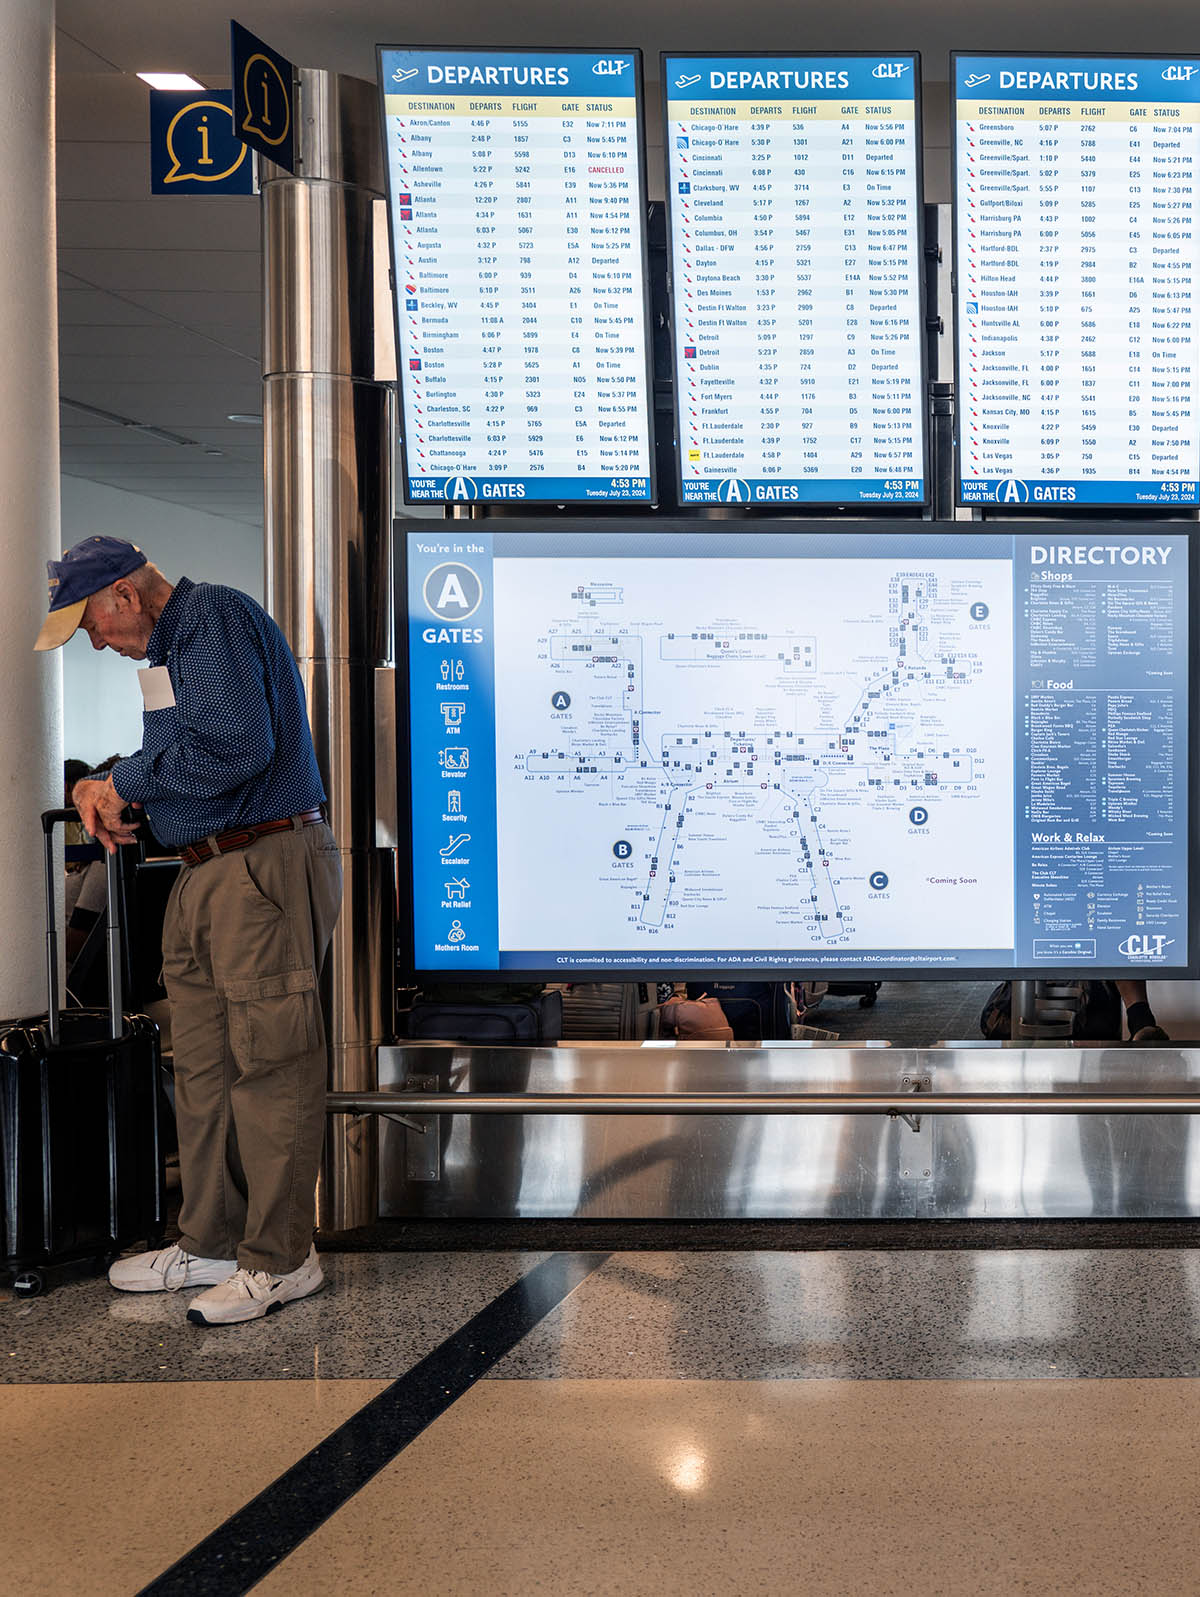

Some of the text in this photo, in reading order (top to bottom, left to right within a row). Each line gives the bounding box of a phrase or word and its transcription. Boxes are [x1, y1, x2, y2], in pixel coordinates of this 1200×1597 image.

[598, 60, 623, 75] CLT
[878, 64, 903, 78] CLT
[1168, 66, 1192, 80] CLT
[428, 66, 568, 85] DEPARTURES
[711, 71, 848, 88] DEPARTURES
[1000, 72, 1138, 90] DEPARTURES
[409, 102, 455, 110] DESTINATION
[411, 480, 436, 488] YOU'RE
[453, 478, 525, 499] A GATES
[611, 479, 645, 488] 4:53 PM
[884, 481, 918, 489] 4:53 PM
[1161, 483, 1195, 492] 4:53 PM
[430, 490, 444, 498] THE
[756, 486, 798, 499] GATES
[1034, 487, 1075, 500] GATES
[417, 544, 484, 552] You're in the
[1031, 547, 1172, 565] DIRECTORY
[1040, 571, 1074, 582] Shops
[437, 574, 469, 609] A
[975, 607, 984, 617] E
[423, 627, 485, 643] GATES
[1047, 680, 1073, 689] Food
[556, 696, 566, 706] A
[442, 814, 467, 822] Security
[914, 811, 924, 821] D
[1032, 833, 1106, 843] Work & Relax
[619, 844, 626, 855] B
[1128, 935, 1166, 955] CLT
